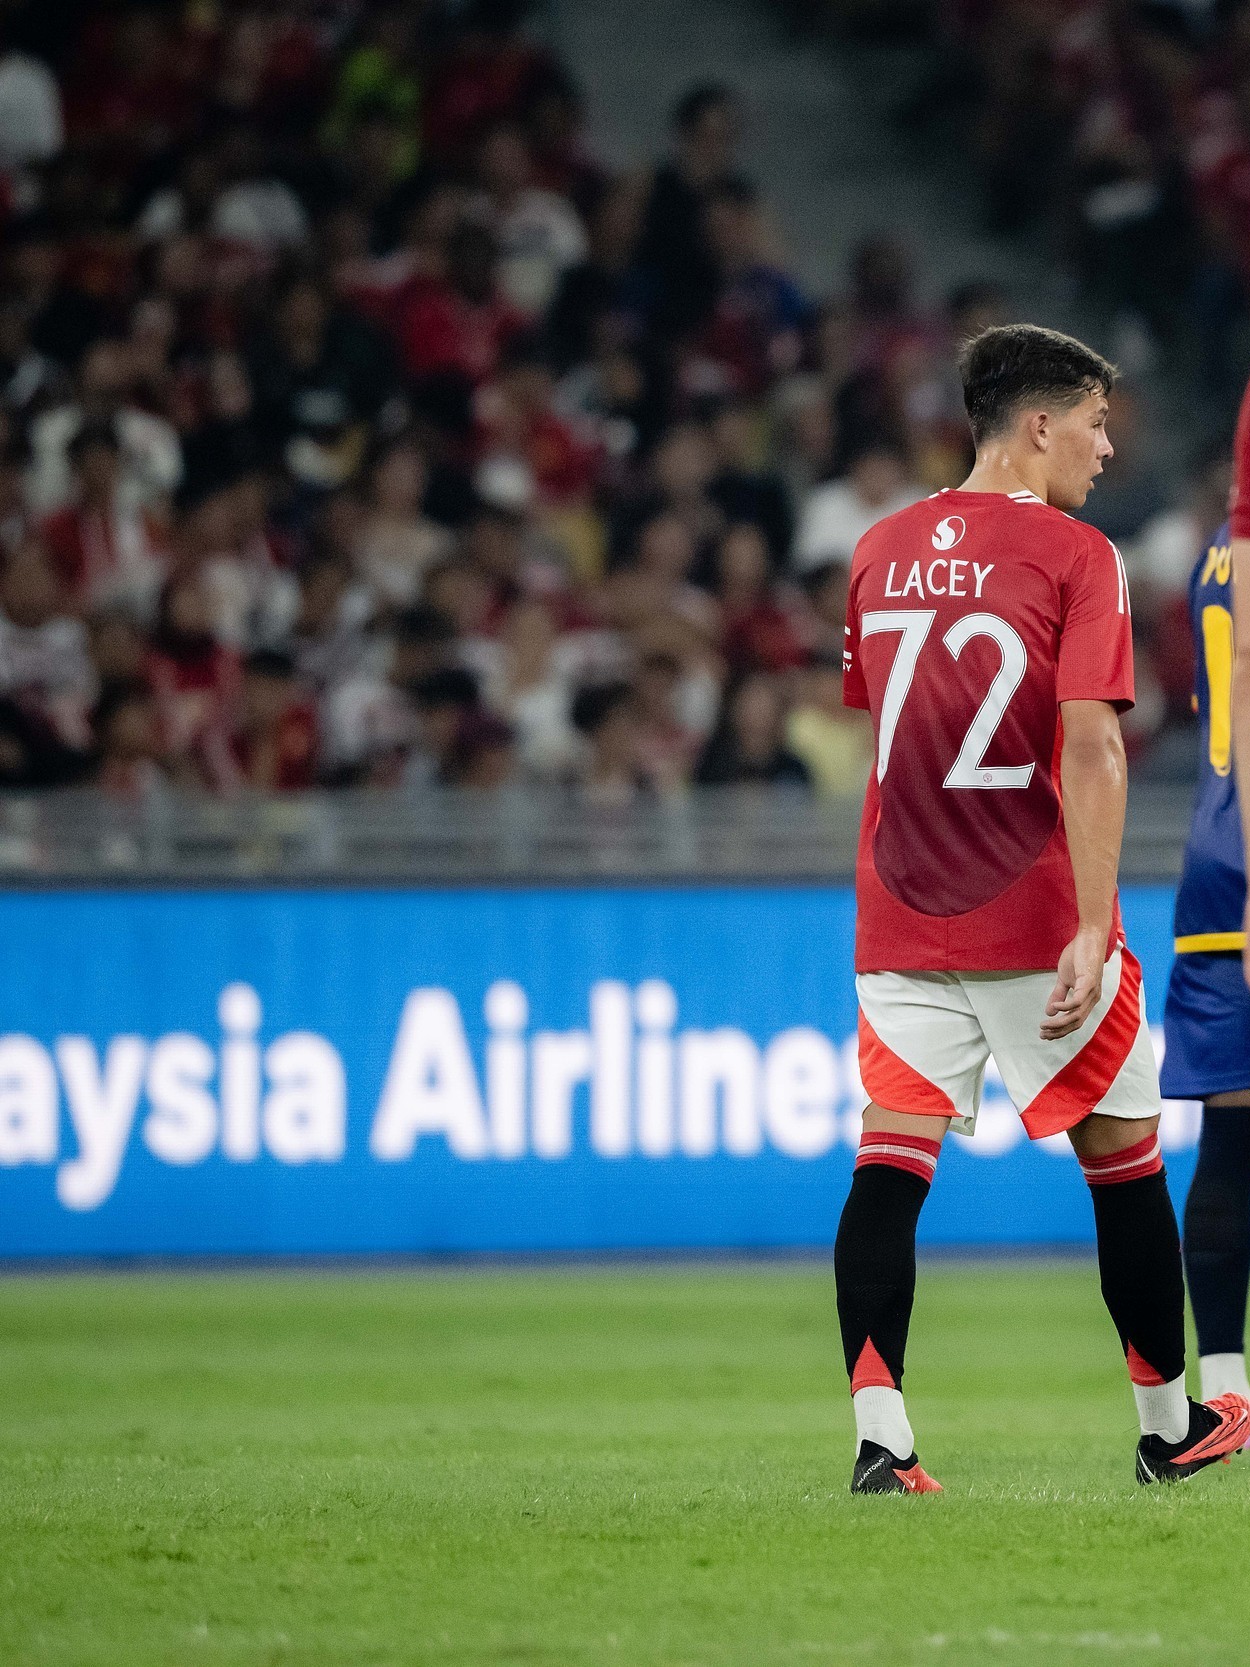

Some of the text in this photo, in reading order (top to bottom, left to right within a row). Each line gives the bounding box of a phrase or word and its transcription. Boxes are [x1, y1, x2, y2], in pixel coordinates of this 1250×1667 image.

[885, 558, 995, 601] LACEY
[861, 609, 1036, 789] 72
[0, 982, 347, 1211] aysia
[370, 978, 863, 1160] Airline
